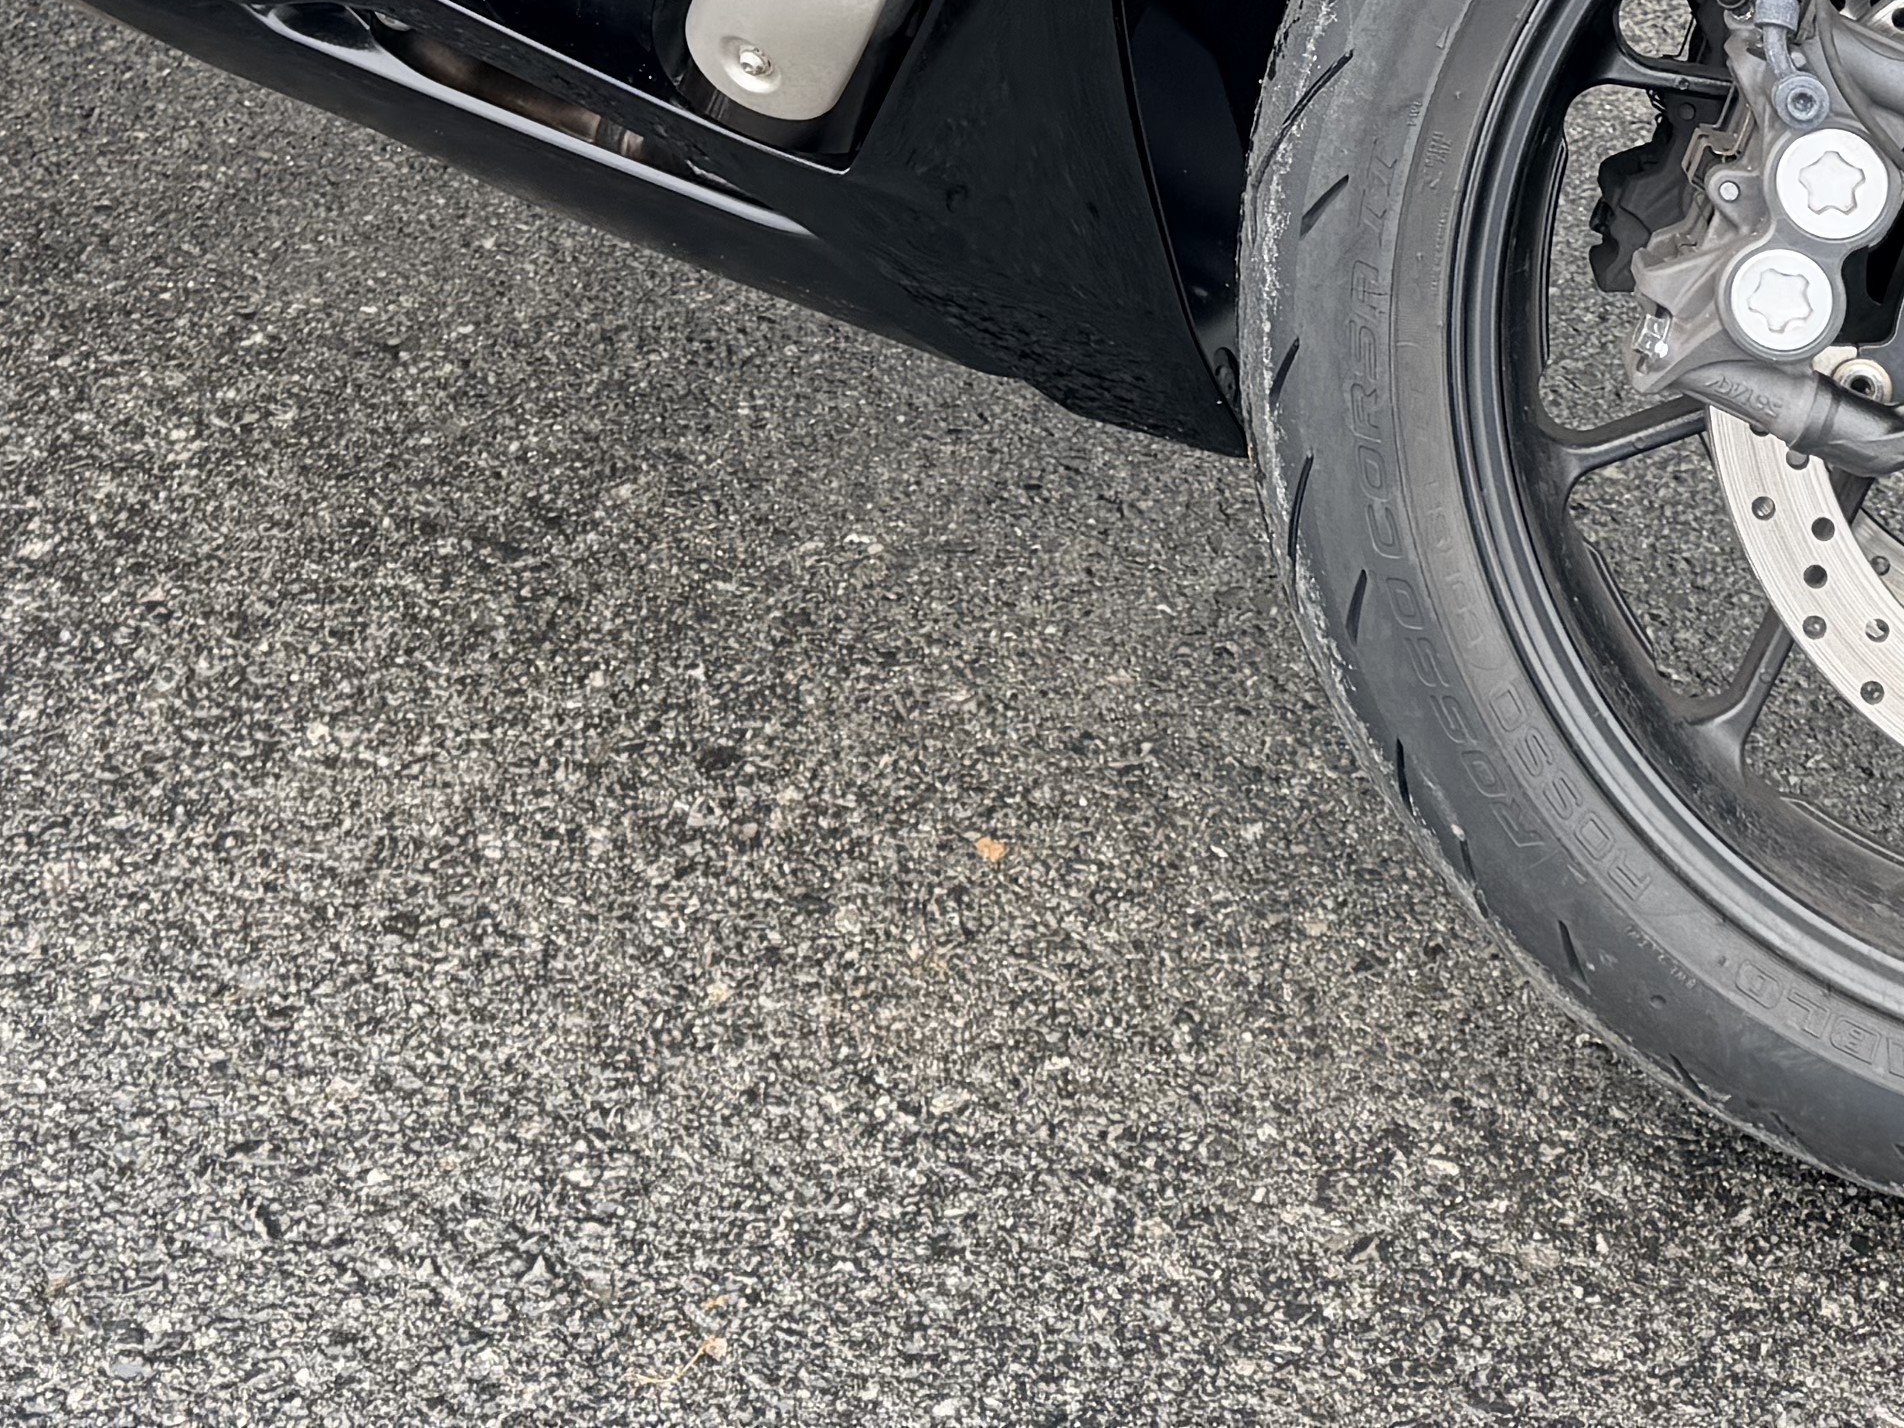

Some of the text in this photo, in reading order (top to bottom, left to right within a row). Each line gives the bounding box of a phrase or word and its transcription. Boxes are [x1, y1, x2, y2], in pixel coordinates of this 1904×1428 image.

[1345, 257, 1410, 565] CORSA
[1377, 568, 1556, 864] ROSSO
[1479, 677, 1664, 904] ROSSO
